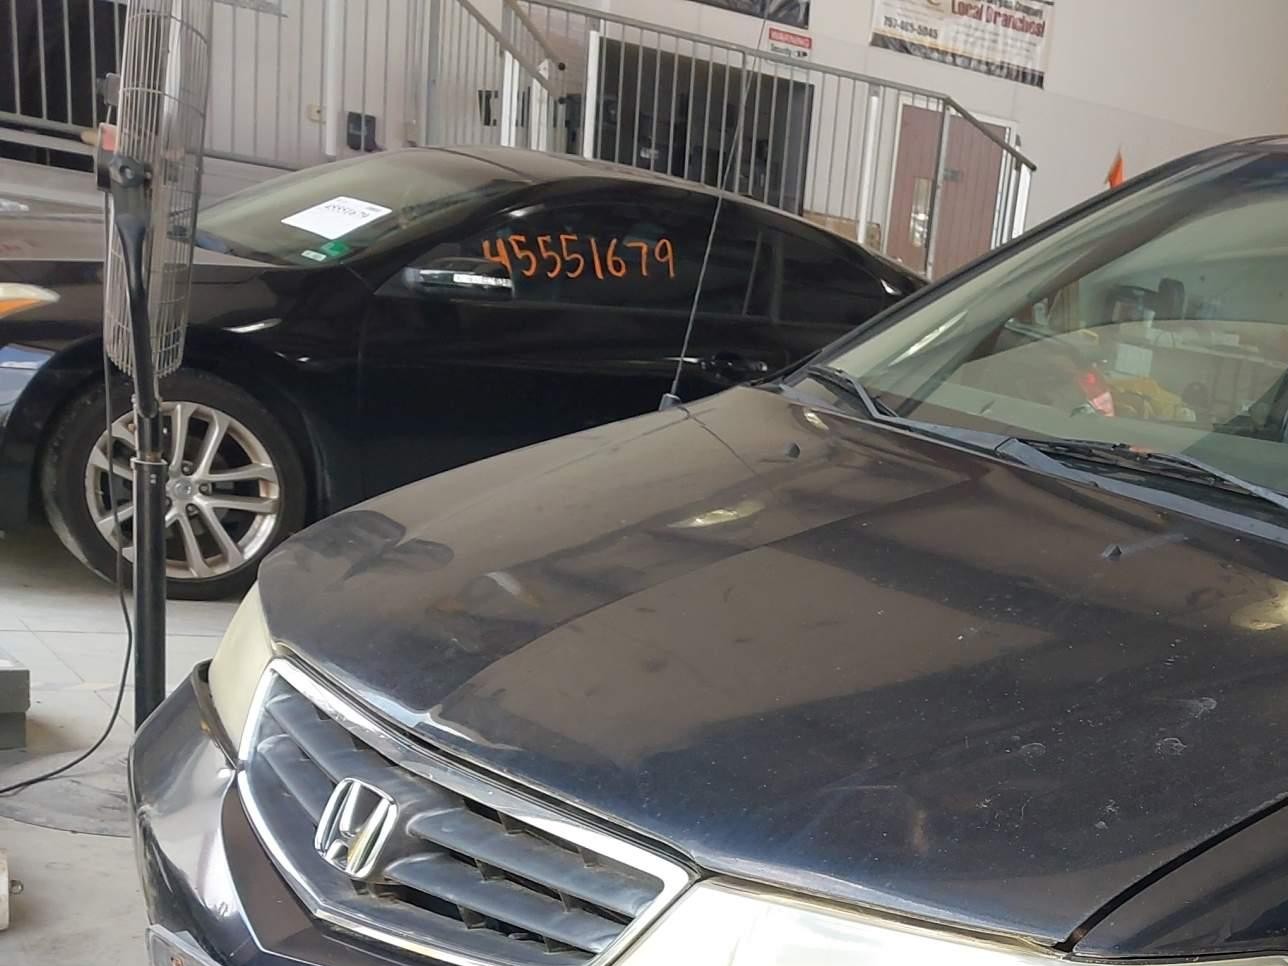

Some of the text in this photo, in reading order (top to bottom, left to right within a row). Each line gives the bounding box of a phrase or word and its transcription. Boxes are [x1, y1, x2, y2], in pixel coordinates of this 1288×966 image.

[952, 0, 983, 21] Local
[985, 5, 1046, 38] Branches!
[481, 234, 675, 280] 45551679
